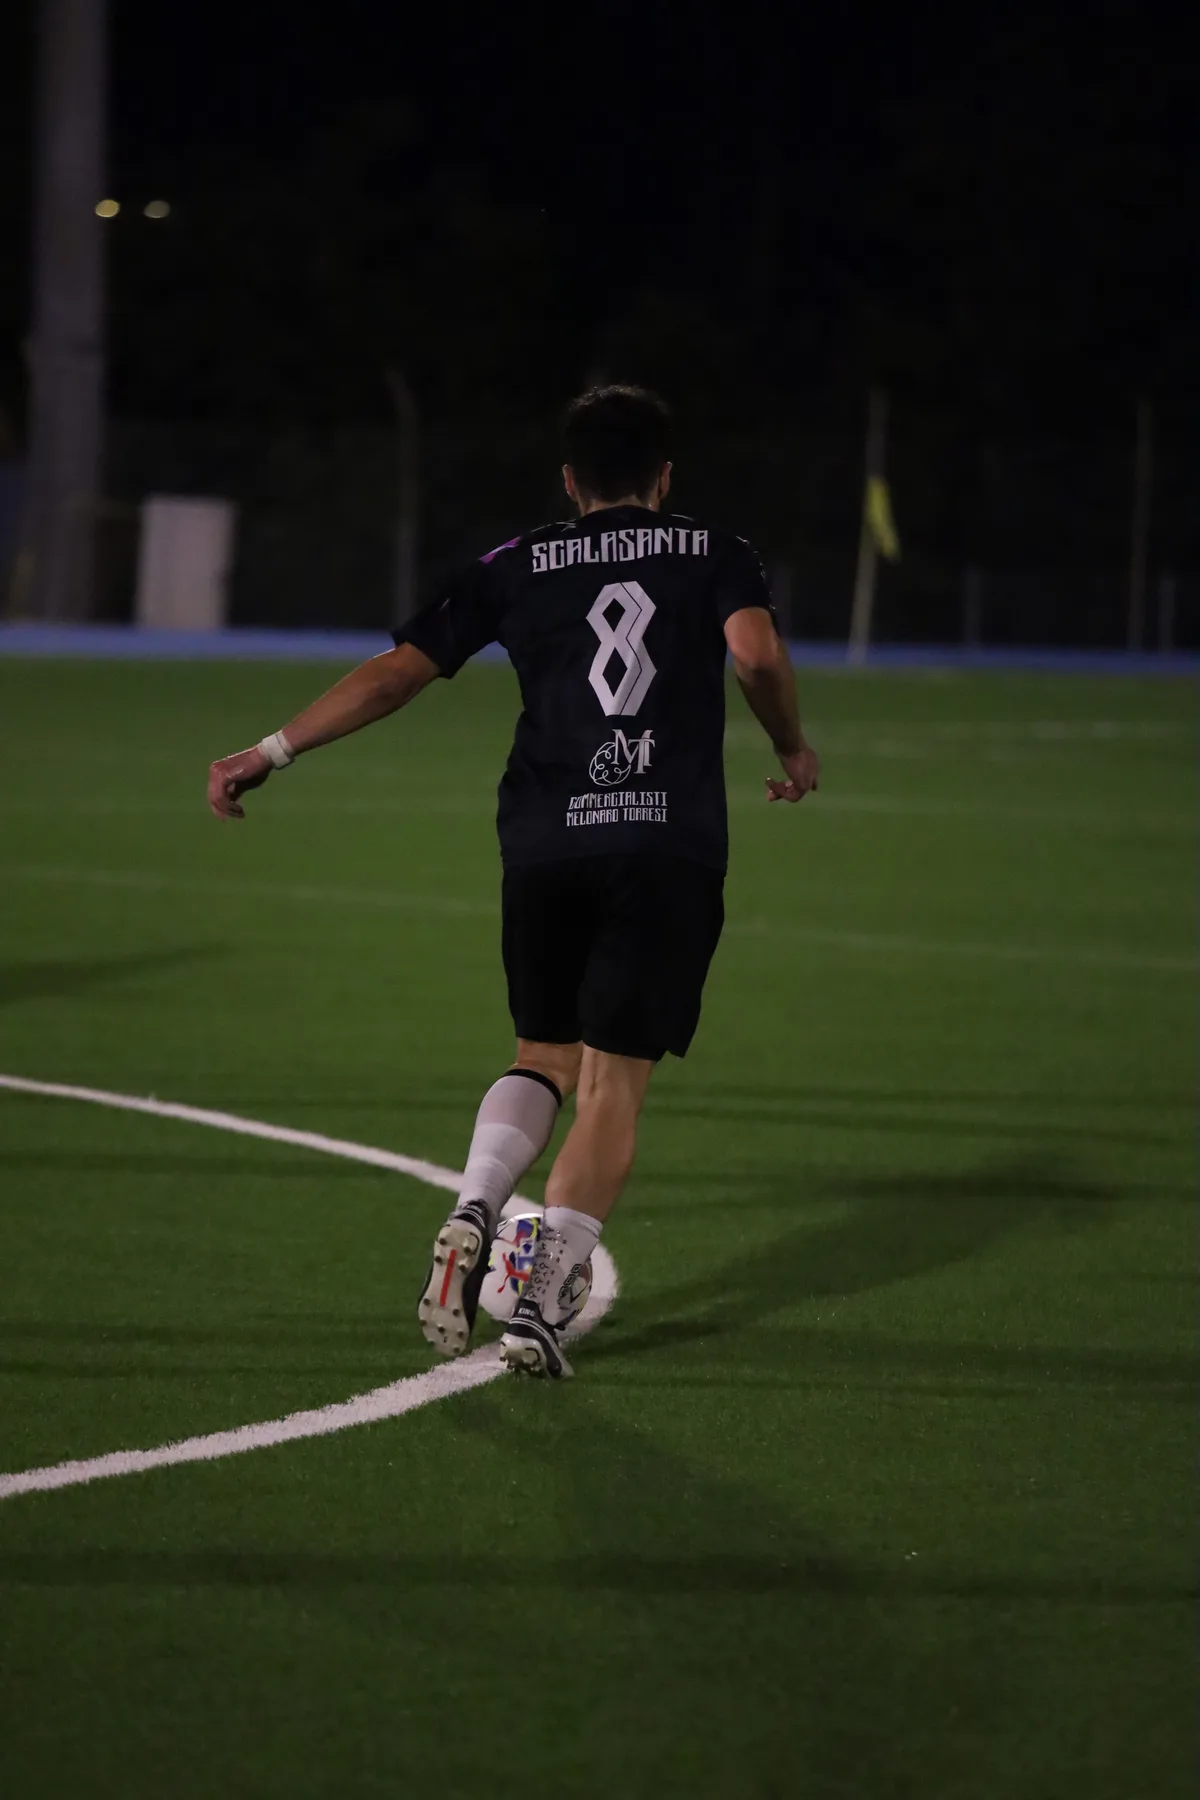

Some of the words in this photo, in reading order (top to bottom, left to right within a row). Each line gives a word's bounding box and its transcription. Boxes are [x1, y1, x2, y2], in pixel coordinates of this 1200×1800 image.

[531, 527, 709, 573] SCALASANTA
[585, 580, 657, 717] 8
[568, 791, 668, 810] COMMERCIALISTI
[623, 807, 668, 823] TORRESI
